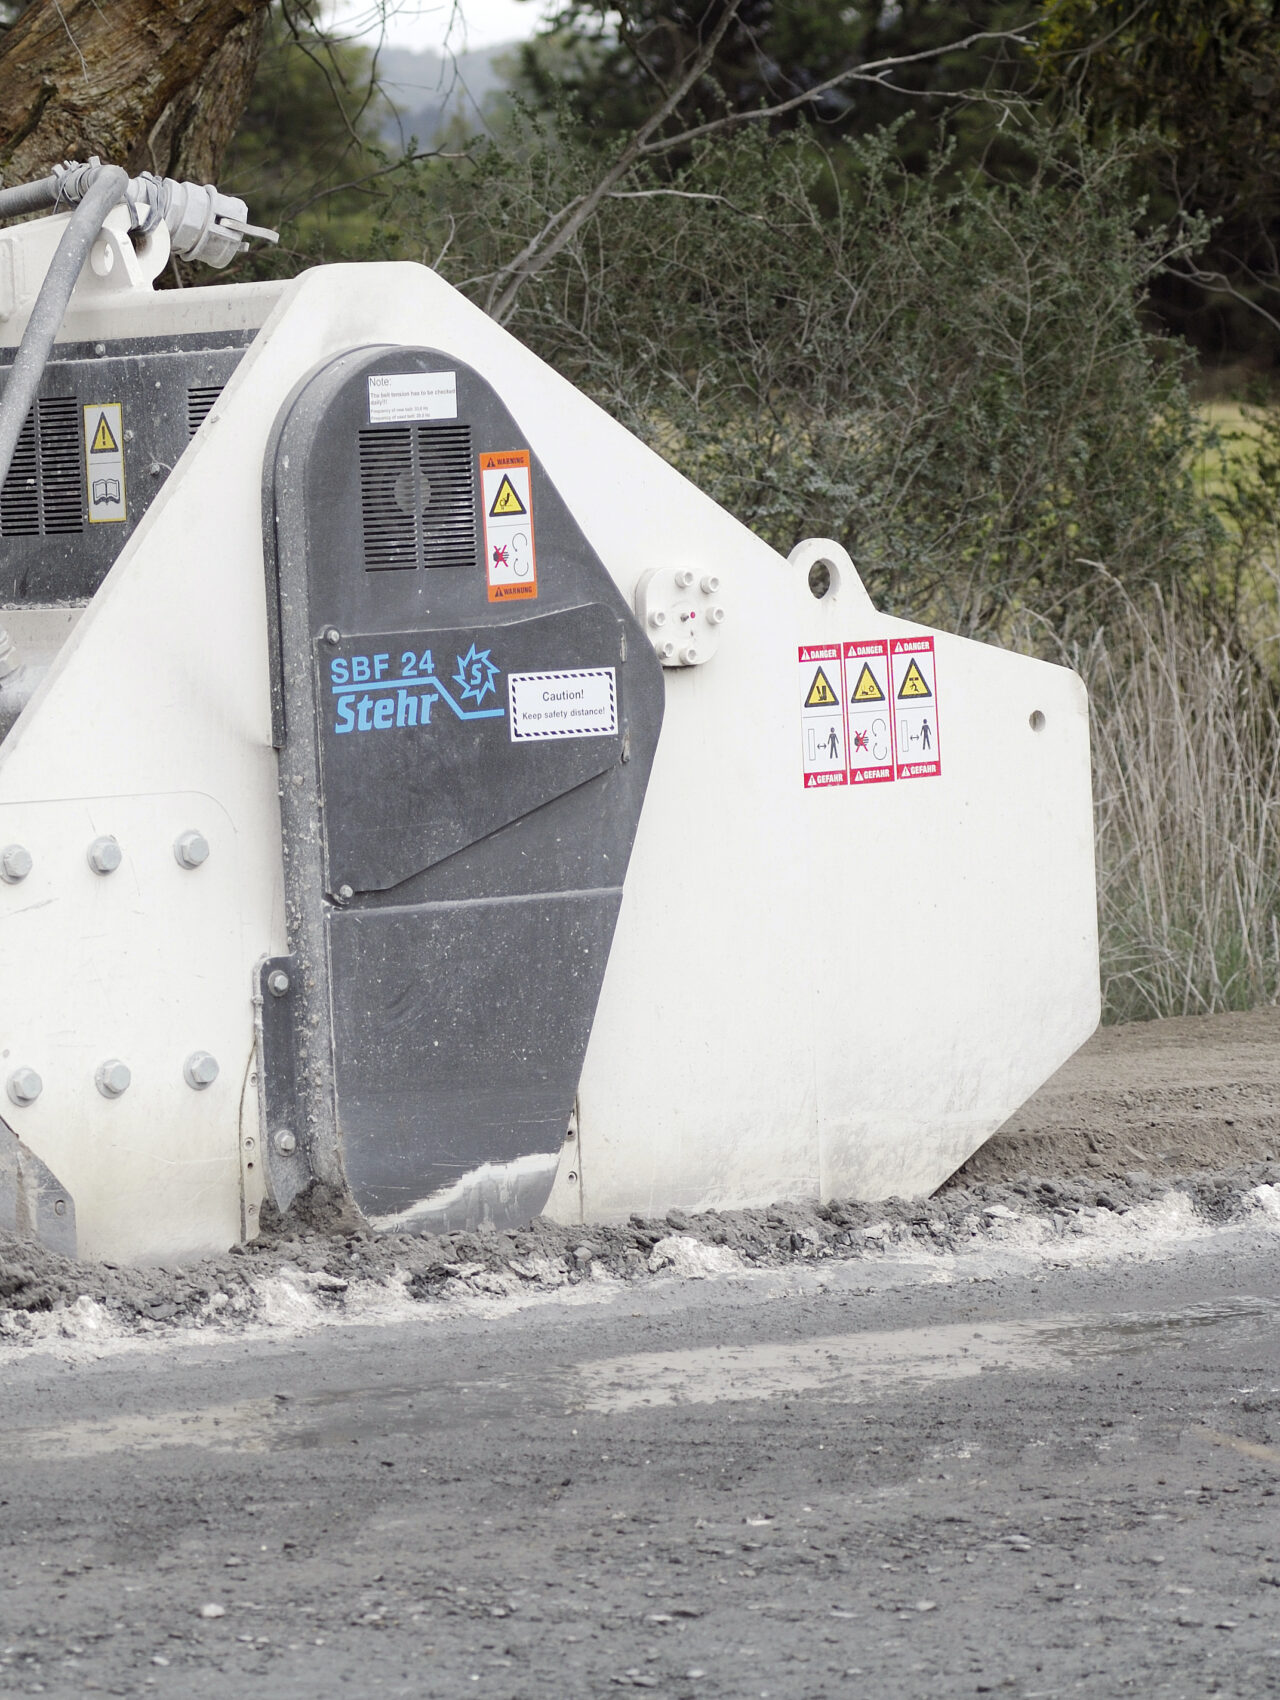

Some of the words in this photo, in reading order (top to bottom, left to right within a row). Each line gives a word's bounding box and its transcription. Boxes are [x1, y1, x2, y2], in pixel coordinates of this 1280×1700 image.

[369, 377, 392, 387] Note:
[497, 456, 525, 465] WARNING
[504, 586, 533, 595] WARNUNG
[857, 645, 883, 655] DANGER
[903, 641, 930, 651] DANGER
[810, 649, 837, 659] DANGER
[331, 653, 389, 684] SBF
[401, 650, 435, 677] 24
[542, 689, 584, 702] Caution!
[335, 689, 439, 734] Stehr
[522, 711, 542, 721] Keep
[544, 709, 568, 719] safety
[570, 707, 605, 717] distance!
[863, 769, 890, 779] GEFAHR
[910, 764, 937, 774] GEFAHR
[816, 774, 843, 784] GEFAHR
